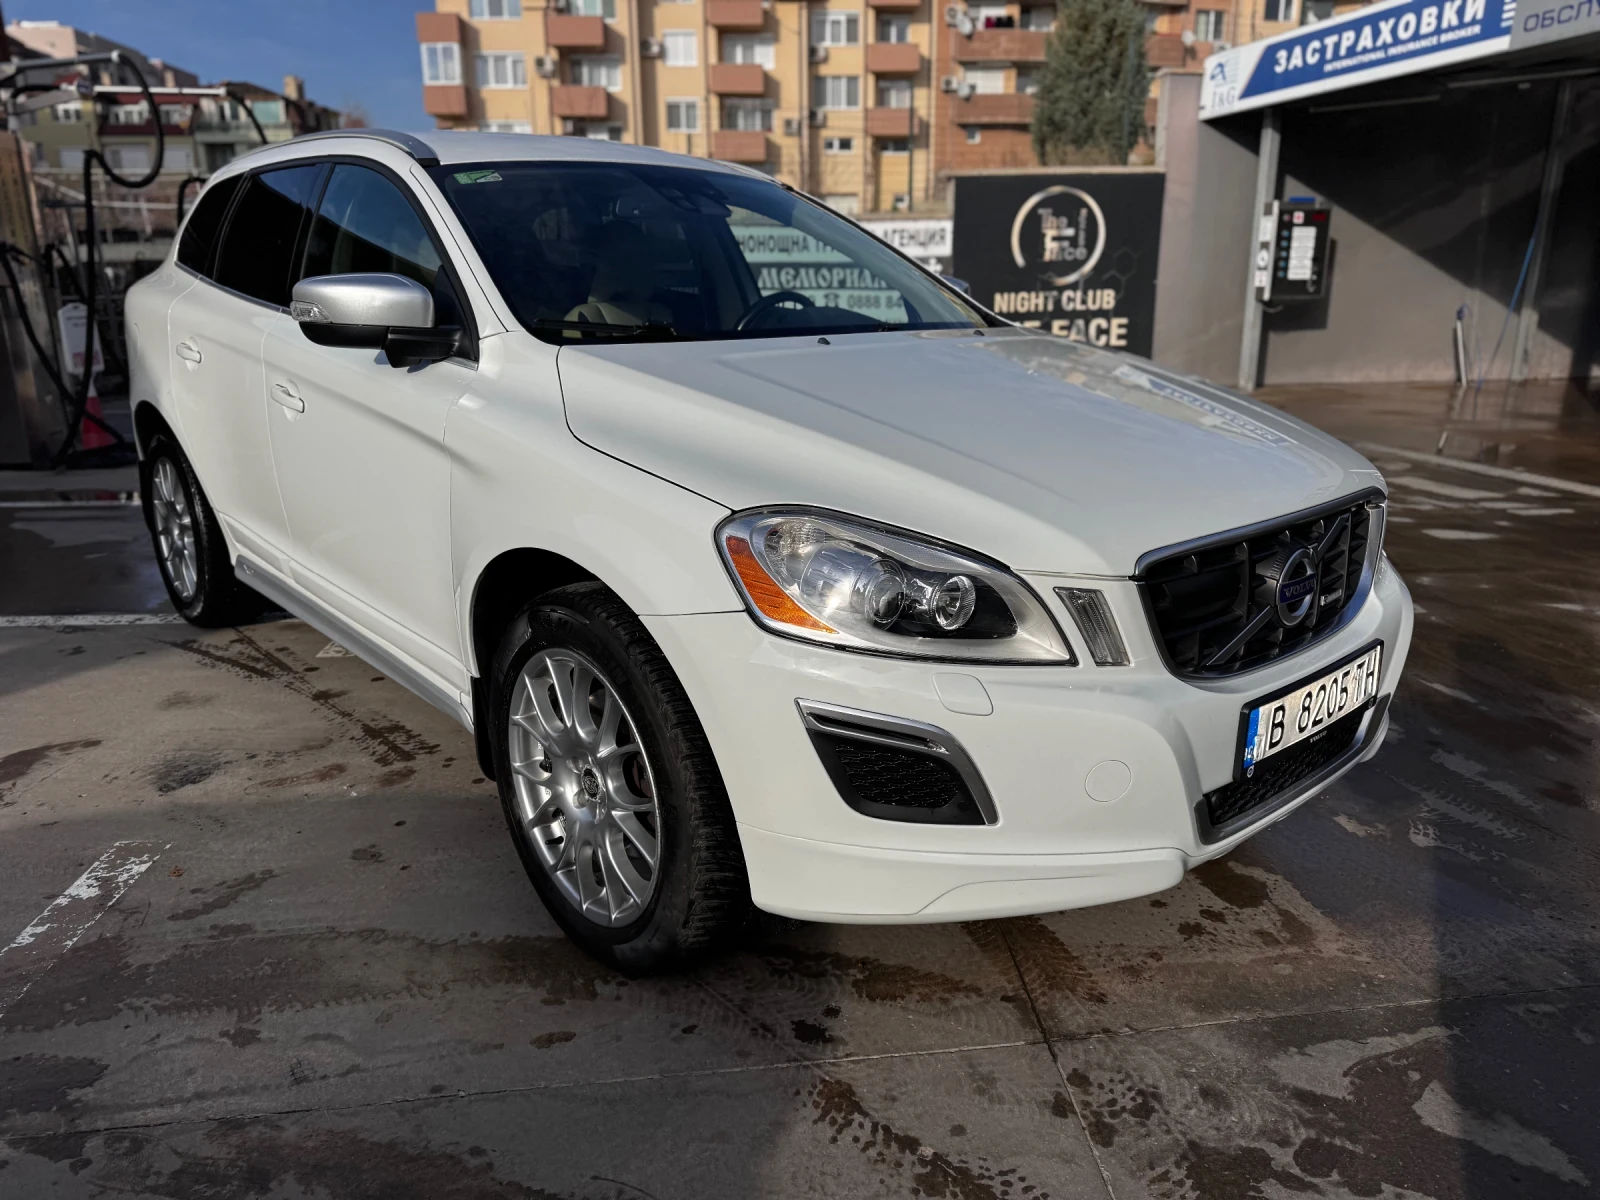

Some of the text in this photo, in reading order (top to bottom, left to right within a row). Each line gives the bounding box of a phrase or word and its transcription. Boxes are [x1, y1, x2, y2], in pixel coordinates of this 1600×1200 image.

[1274, 0, 1486, 73] ЗАСТРАХОВКИ
[1323, 24, 1481, 72] INTERNATIONAL INSURANCE BROKER
[994, 289, 1116, 313] NIGHT CLUB
[1284, 577, 1316, 597] VOLVO
[1268, 704, 1285, 751] B
[1297, 669, 1351, 734] 8205
